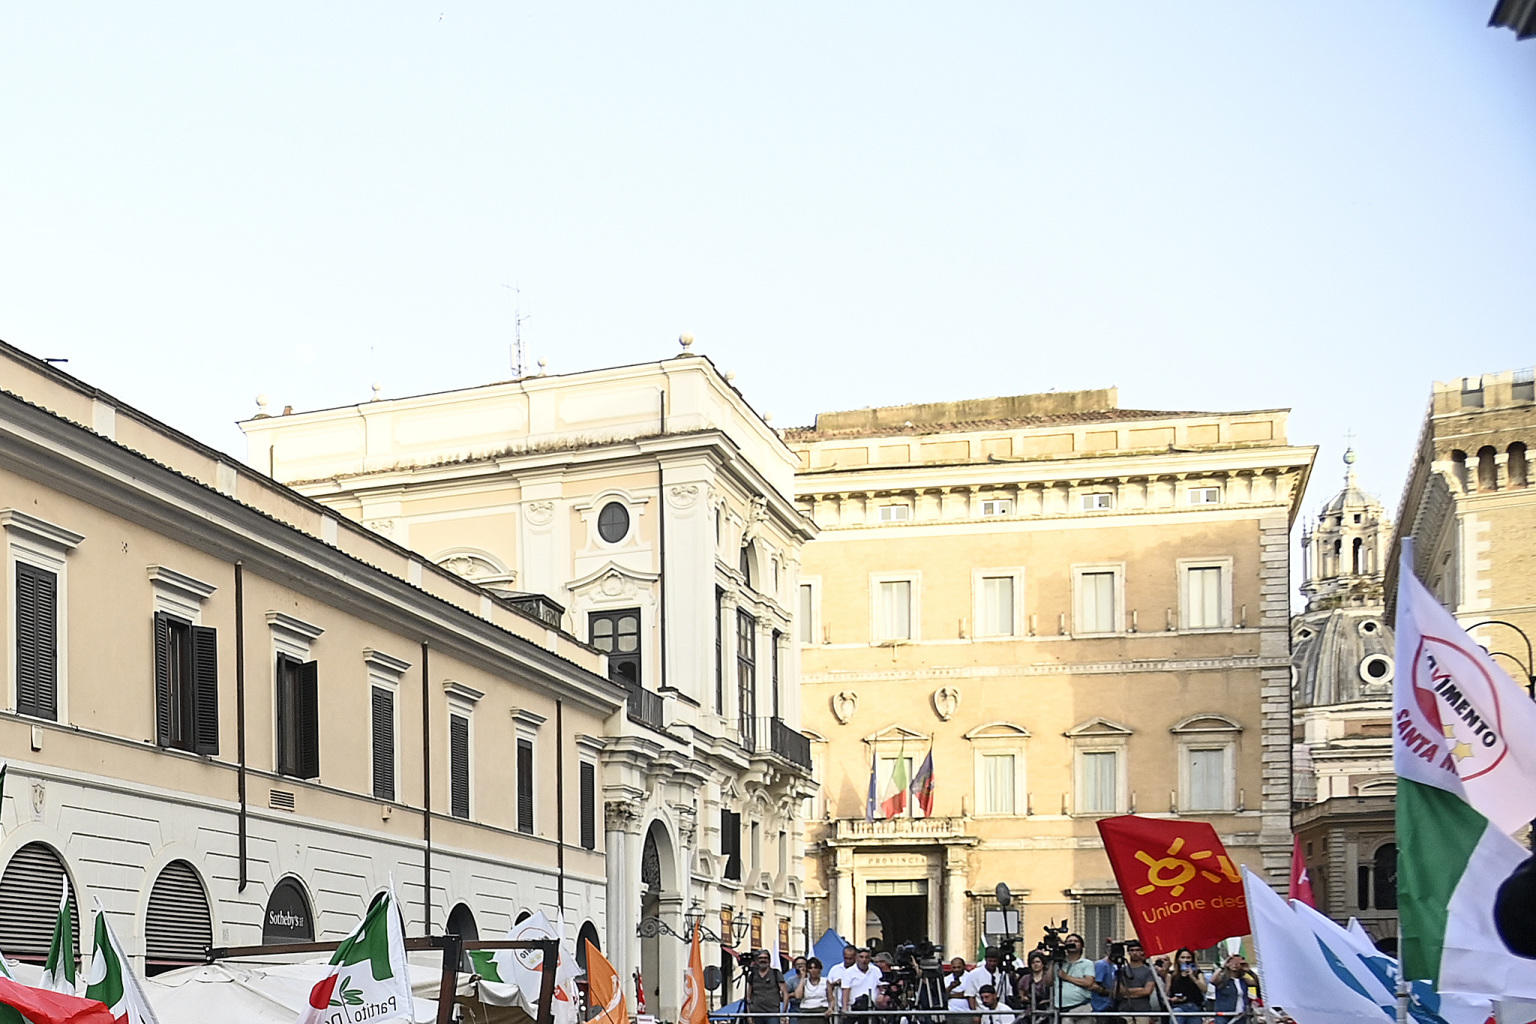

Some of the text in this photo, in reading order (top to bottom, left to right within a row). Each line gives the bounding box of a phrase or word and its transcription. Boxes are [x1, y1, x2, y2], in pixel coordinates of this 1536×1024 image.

[1396, 708, 1440, 763] SANTA
[269, 910, 299, 930] Sotheby's
[1142, 898, 1207, 924] Unione
